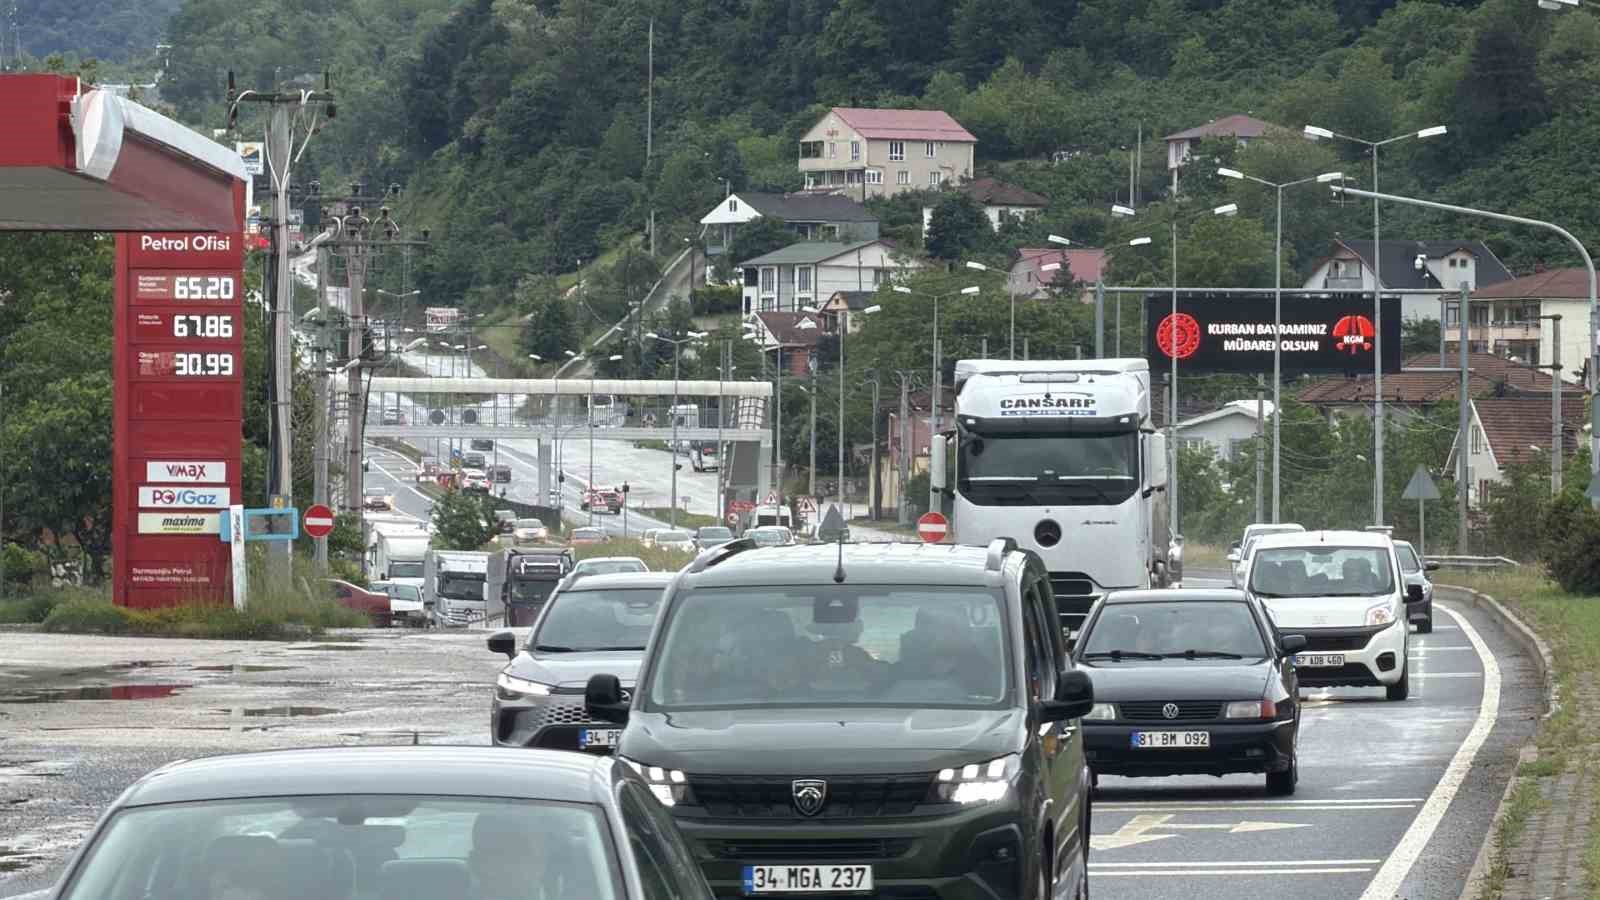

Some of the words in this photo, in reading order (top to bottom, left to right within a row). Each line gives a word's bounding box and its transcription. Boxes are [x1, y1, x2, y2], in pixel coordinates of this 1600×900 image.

[141, 236, 188, 251] Petrol
[192, 236, 230, 251] Ofisi
[175, 277, 233, 299] 65.20
[174, 315, 232, 337] 67.86
[1208, 324, 1254, 335] KURBAN
[1281, 340, 1319, 351] OLSUN
[1343, 335, 1364, 344] KGM
[176, 353, 232, 375] 30.99
[162, 516, 205, 526] maxima
[584, 731, 600, 744] 34
[1139, 733, 1153, 745] 81
[1161, 733, 1177, 745] BM
[1184, 733, 1208, 745] 092
[754, 868, 777, 888] 34
[788, 867, 821, 888] MGA
[831, 867, 866, 888] 237
